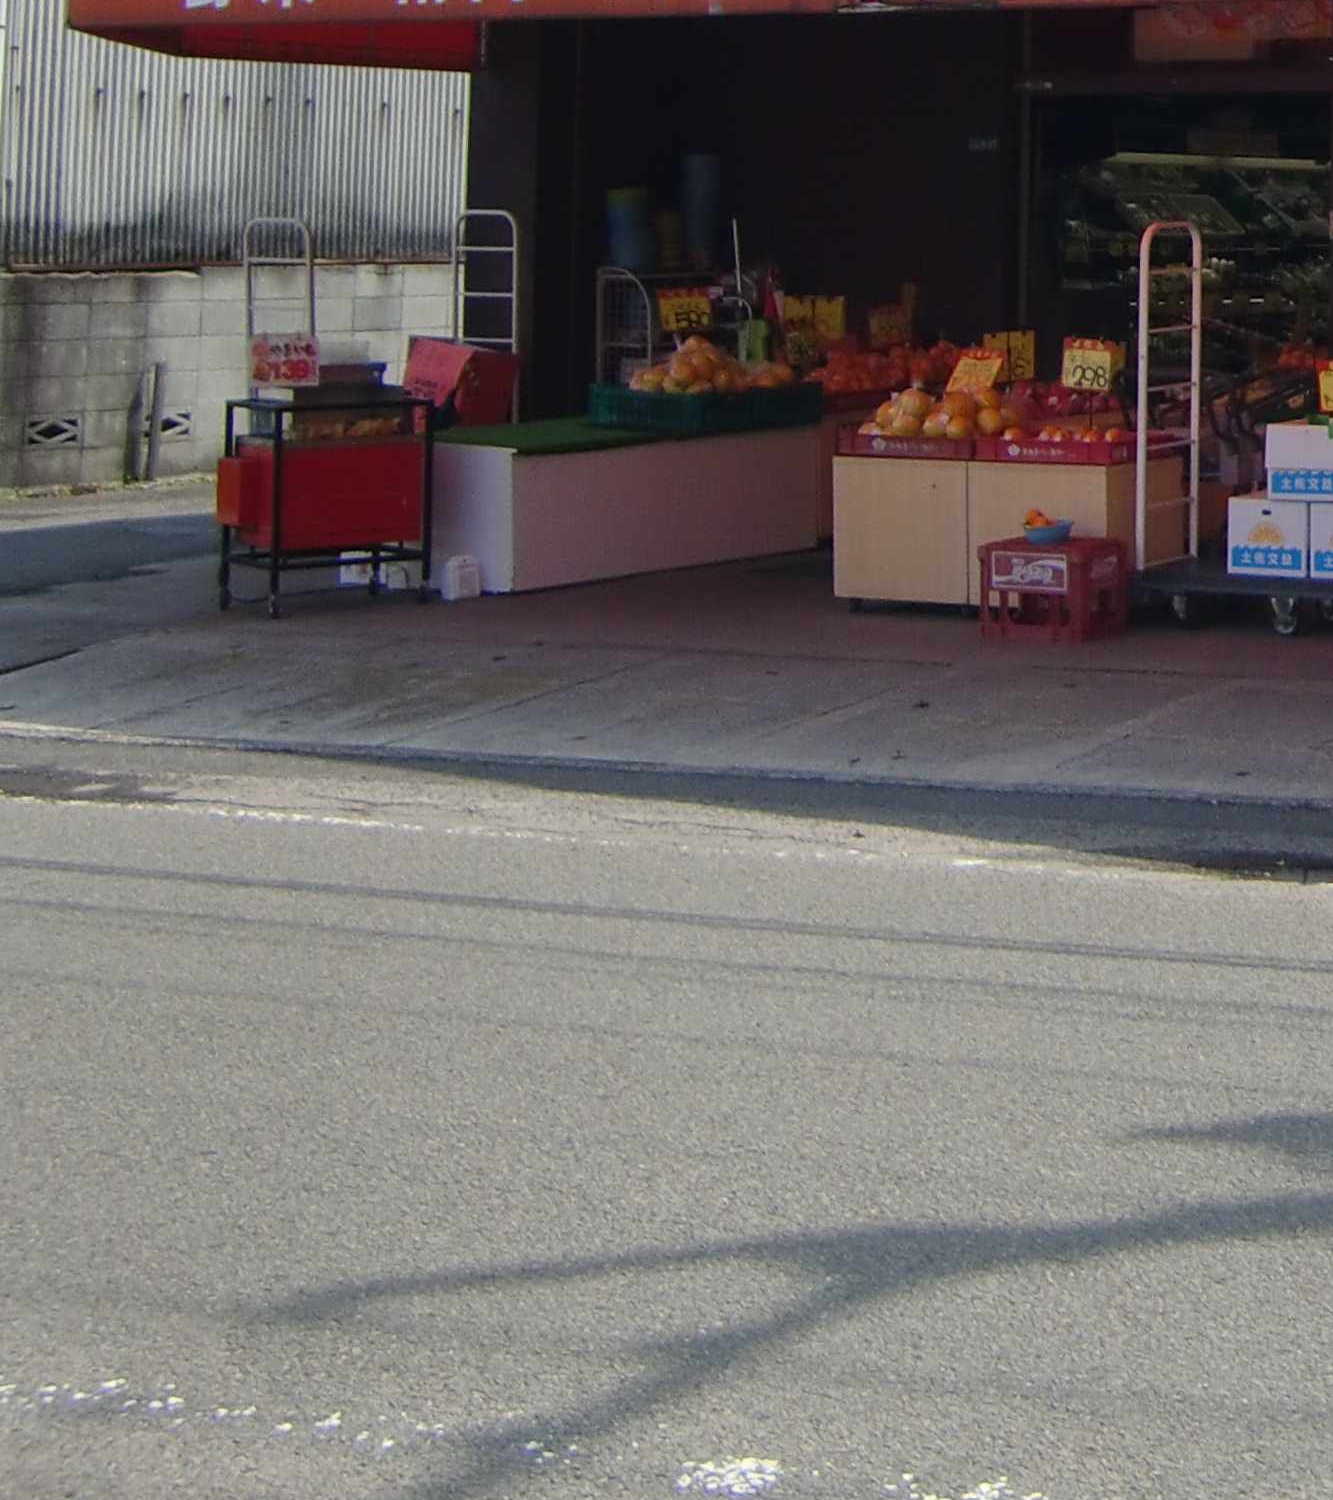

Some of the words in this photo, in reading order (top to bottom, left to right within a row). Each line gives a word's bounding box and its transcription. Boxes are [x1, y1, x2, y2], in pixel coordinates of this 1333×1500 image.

[1072, 365, 1107, 388] 298
[1280, 477, 1333, 492] 土佐文旦
[1241, 551, 1292, 566] 土佐文旦
